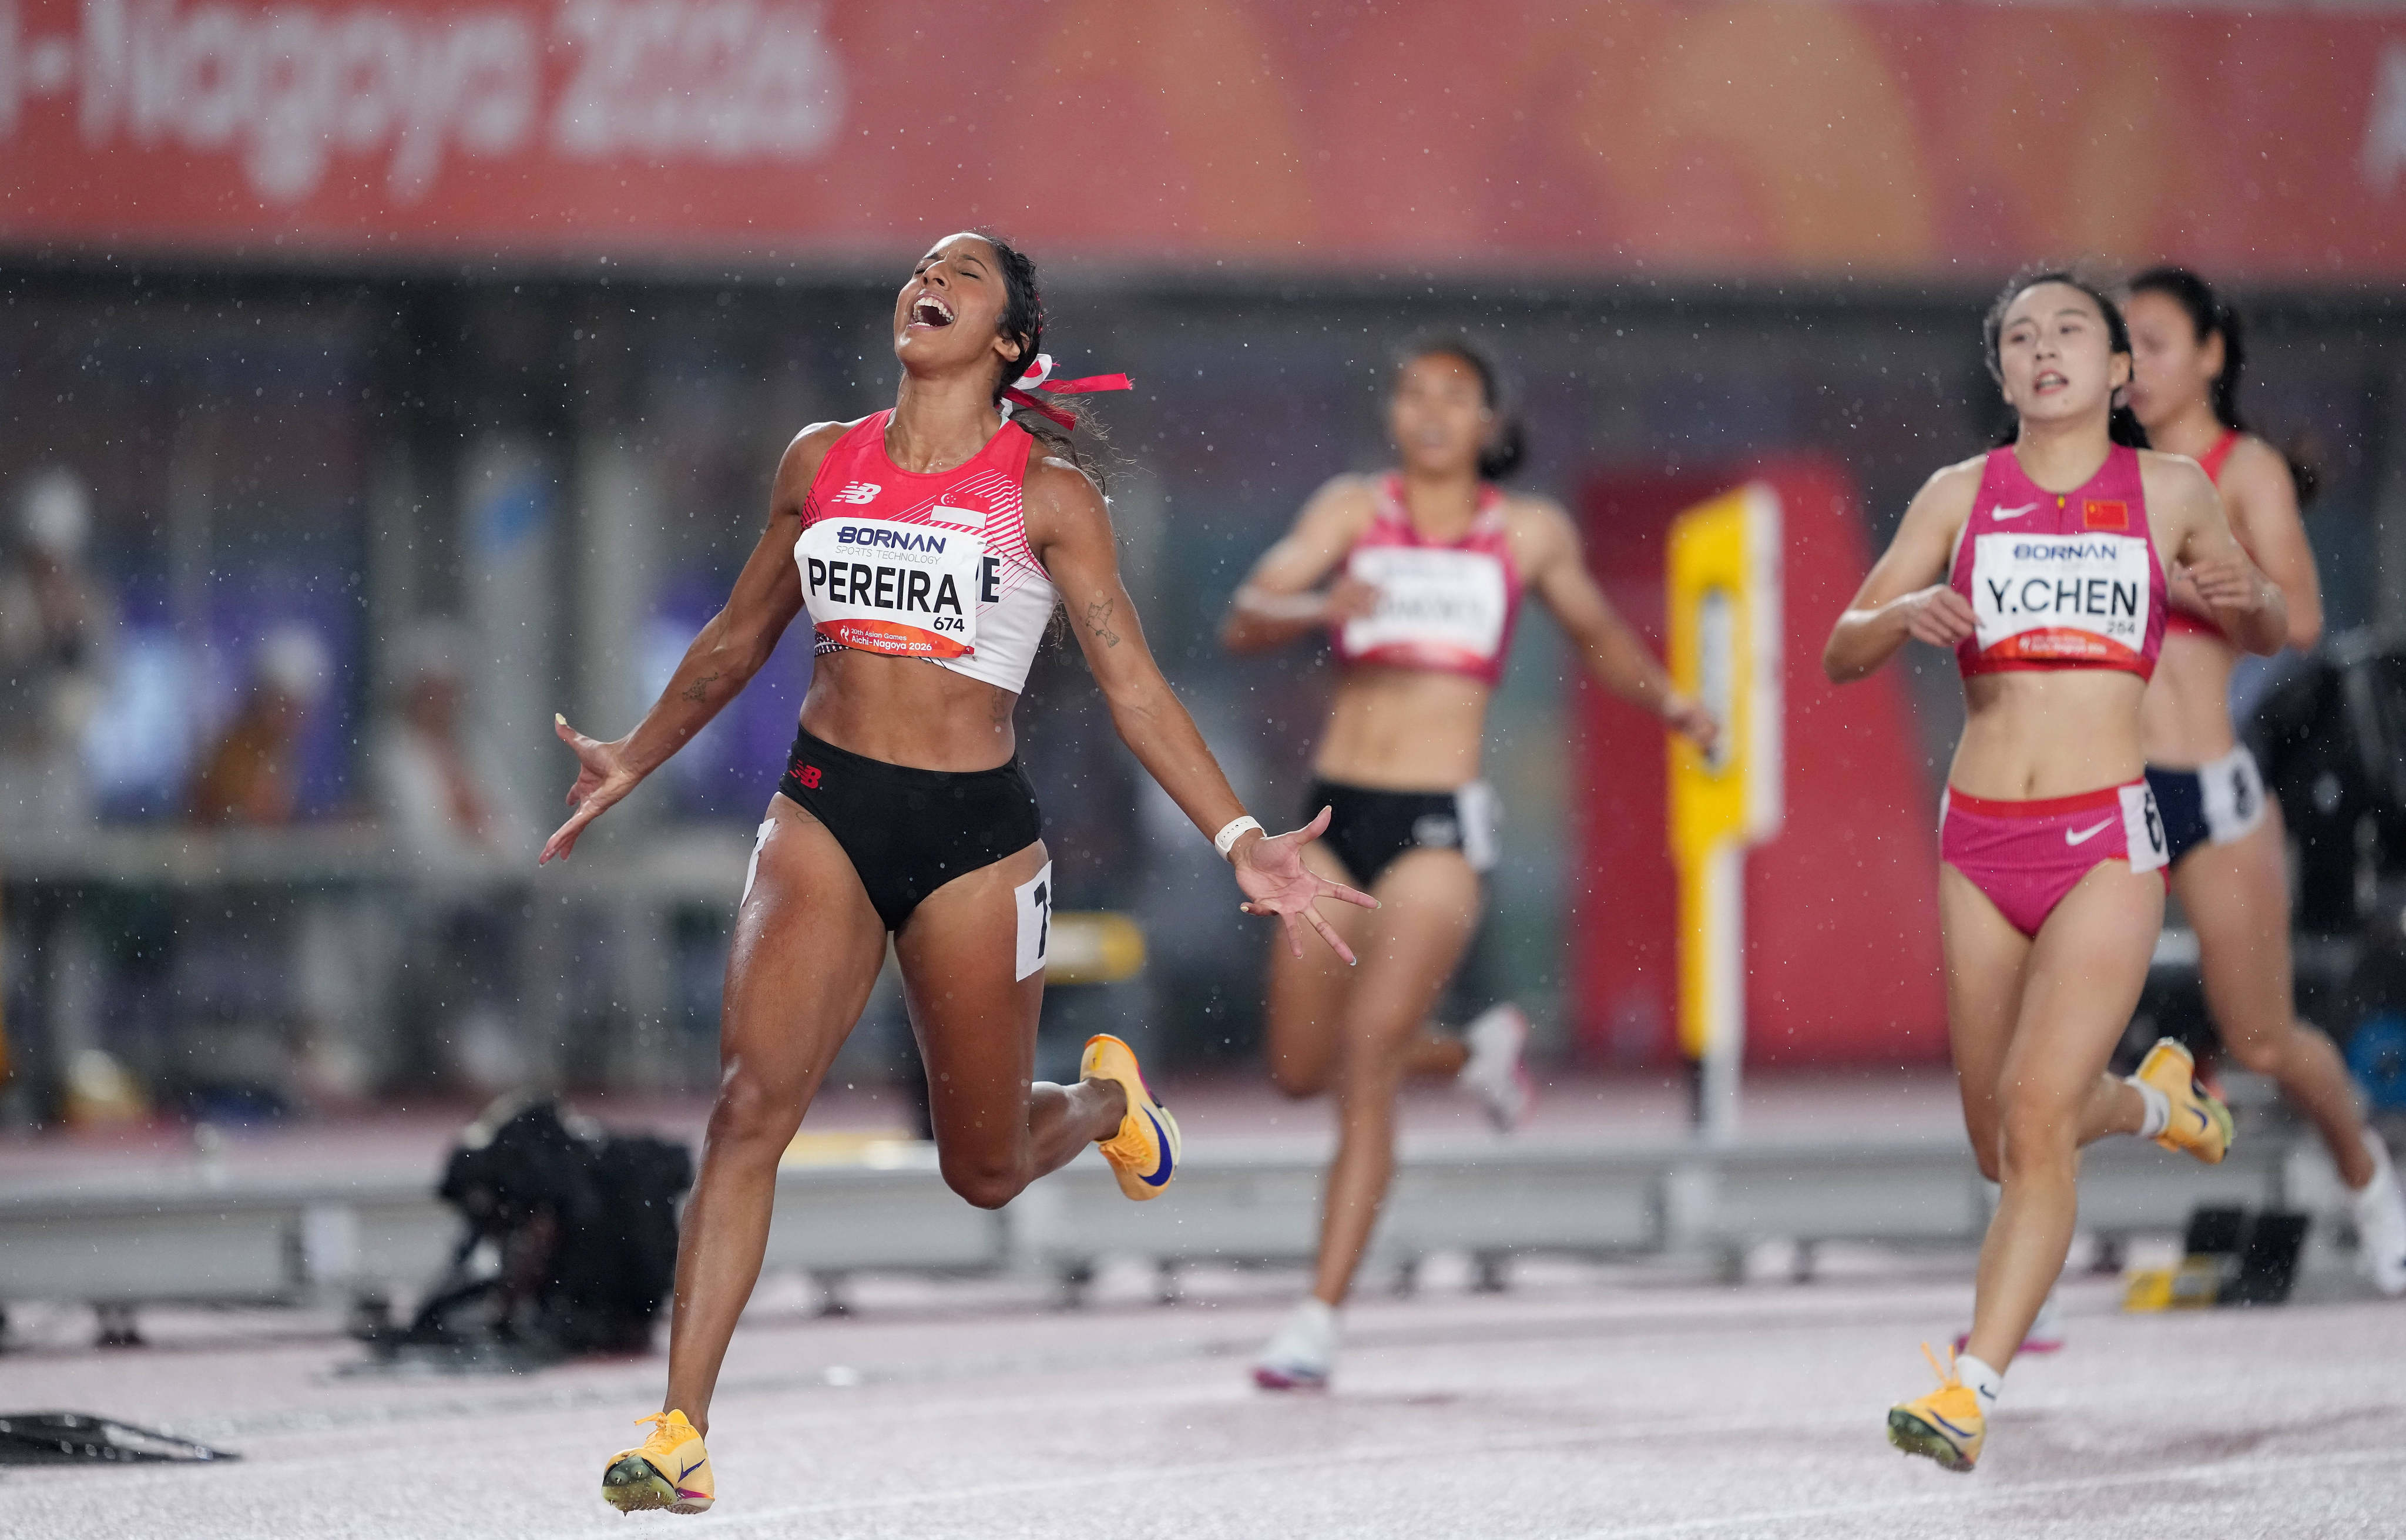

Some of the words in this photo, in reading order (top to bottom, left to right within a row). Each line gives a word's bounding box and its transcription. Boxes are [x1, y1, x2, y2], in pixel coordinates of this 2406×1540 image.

[837, 526, 947, 554] BORNAN
[2012, 543, 2117, 560] BORNAN
[835, 545, 873, 558] SPORTS
[876, 549, 942, 565] TECHNOLOGY
[807, 557, 963, 615] PEREIRA
[975, 556, 1000, 603] E
[1987, 578, 2137, 616] Y.CHEN
[934, 616, 965, 632] 674
[851, 635, 907, 651] Aichi-Nagoya
[908, 642, 932, 651] 2026
[884, 633, 907, 641] Games
[1033, 881, 1048, 959] 7
